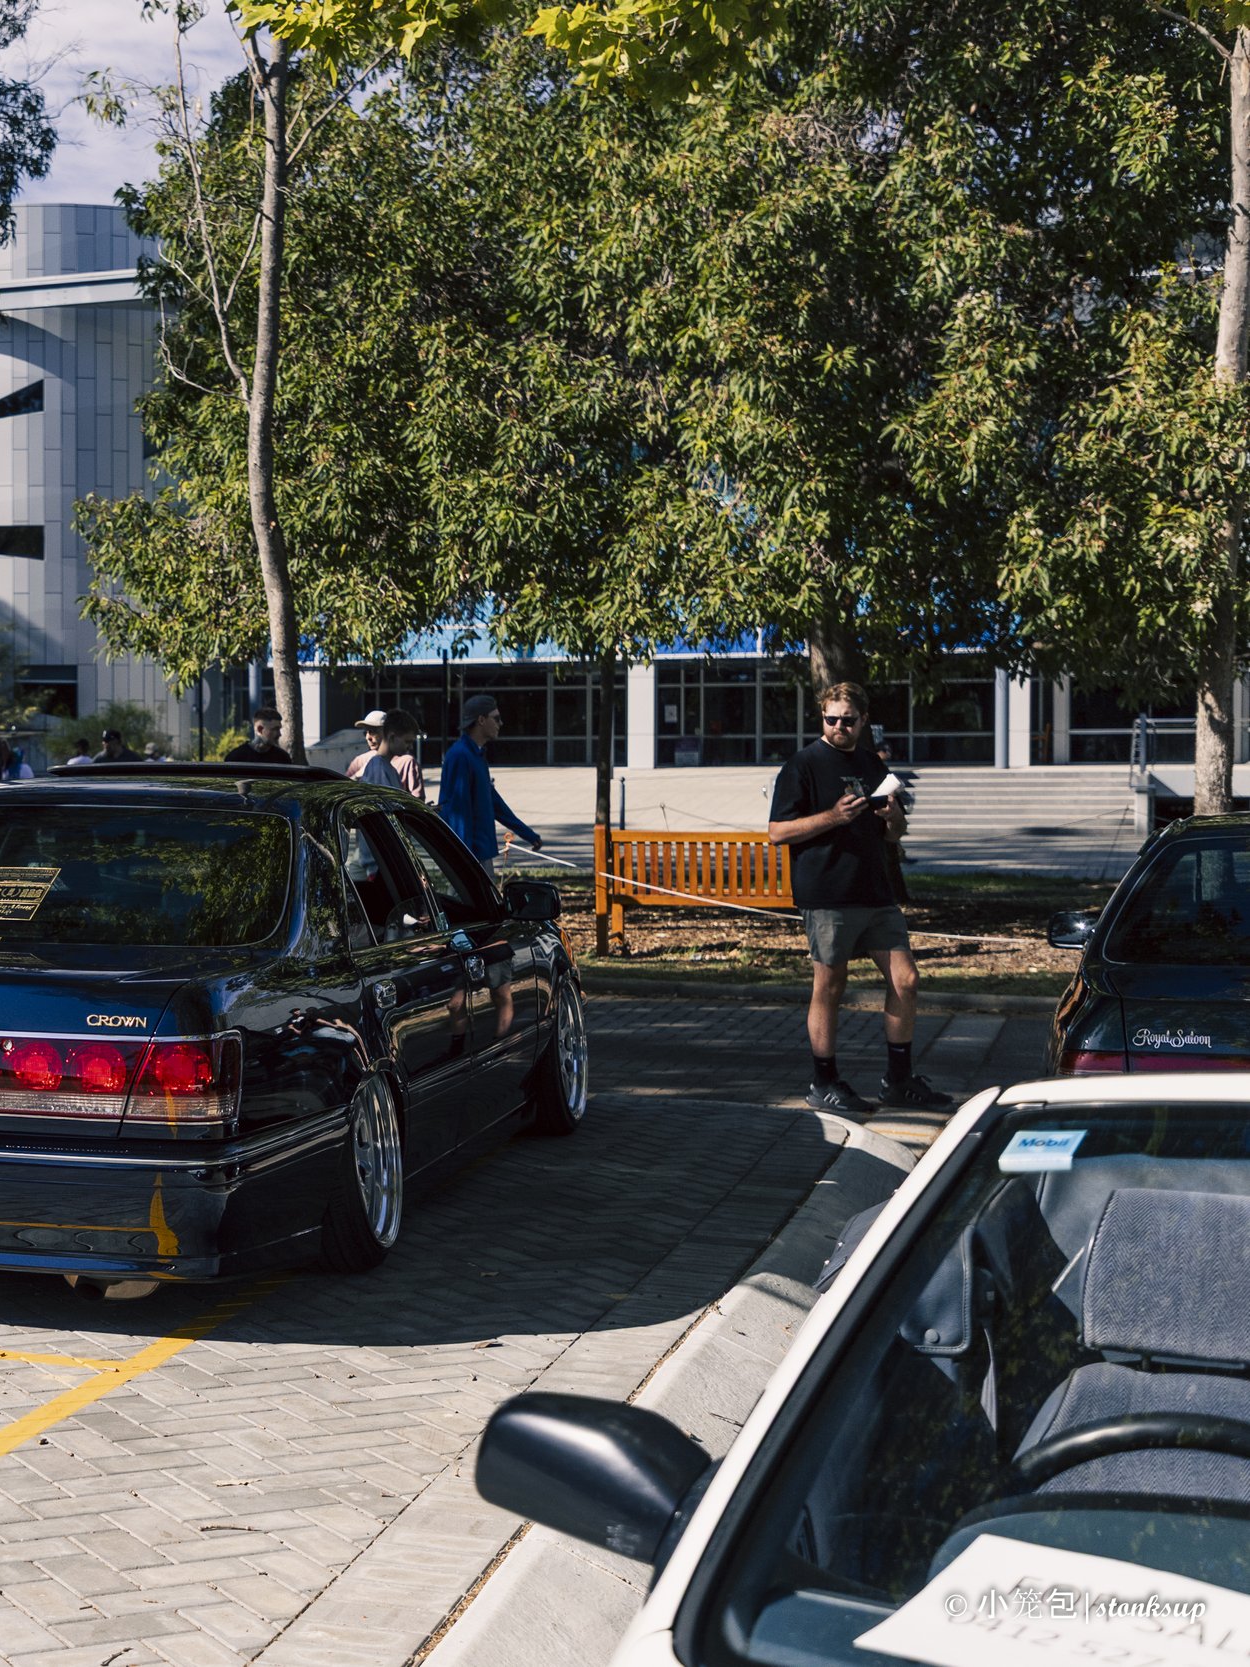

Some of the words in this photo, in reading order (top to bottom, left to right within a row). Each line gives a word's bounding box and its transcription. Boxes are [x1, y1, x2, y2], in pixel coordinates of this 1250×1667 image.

[86, 1014, 147, 1029] CROWN
[1132, 1028, 1170, 1048] Royal
[1169, 1029, 1212, 1048] Saloon
[1018, 1138, 1070, 1147] Mobil
